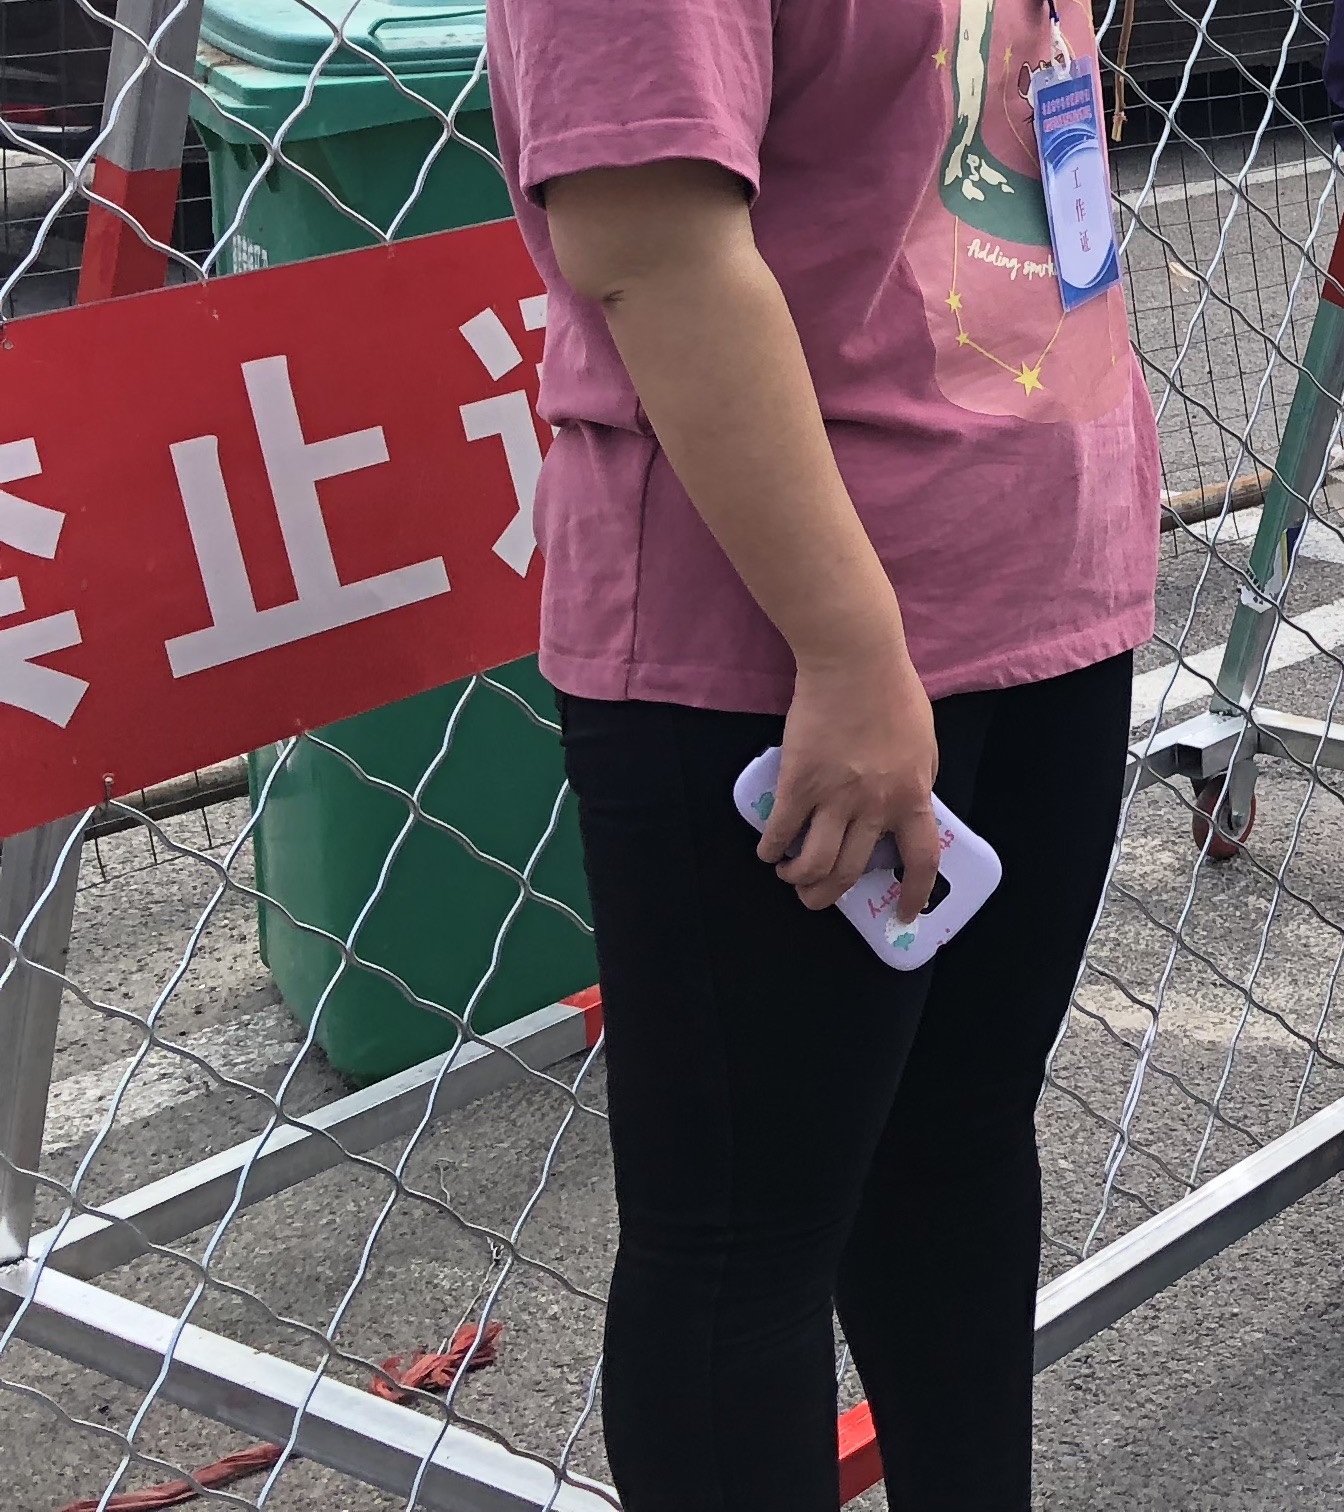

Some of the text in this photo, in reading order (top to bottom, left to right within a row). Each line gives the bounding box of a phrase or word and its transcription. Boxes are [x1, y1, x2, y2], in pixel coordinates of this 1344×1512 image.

[1071, 167, 1091, 252] 工作证
[967, 239, 1021, 280] Adding
